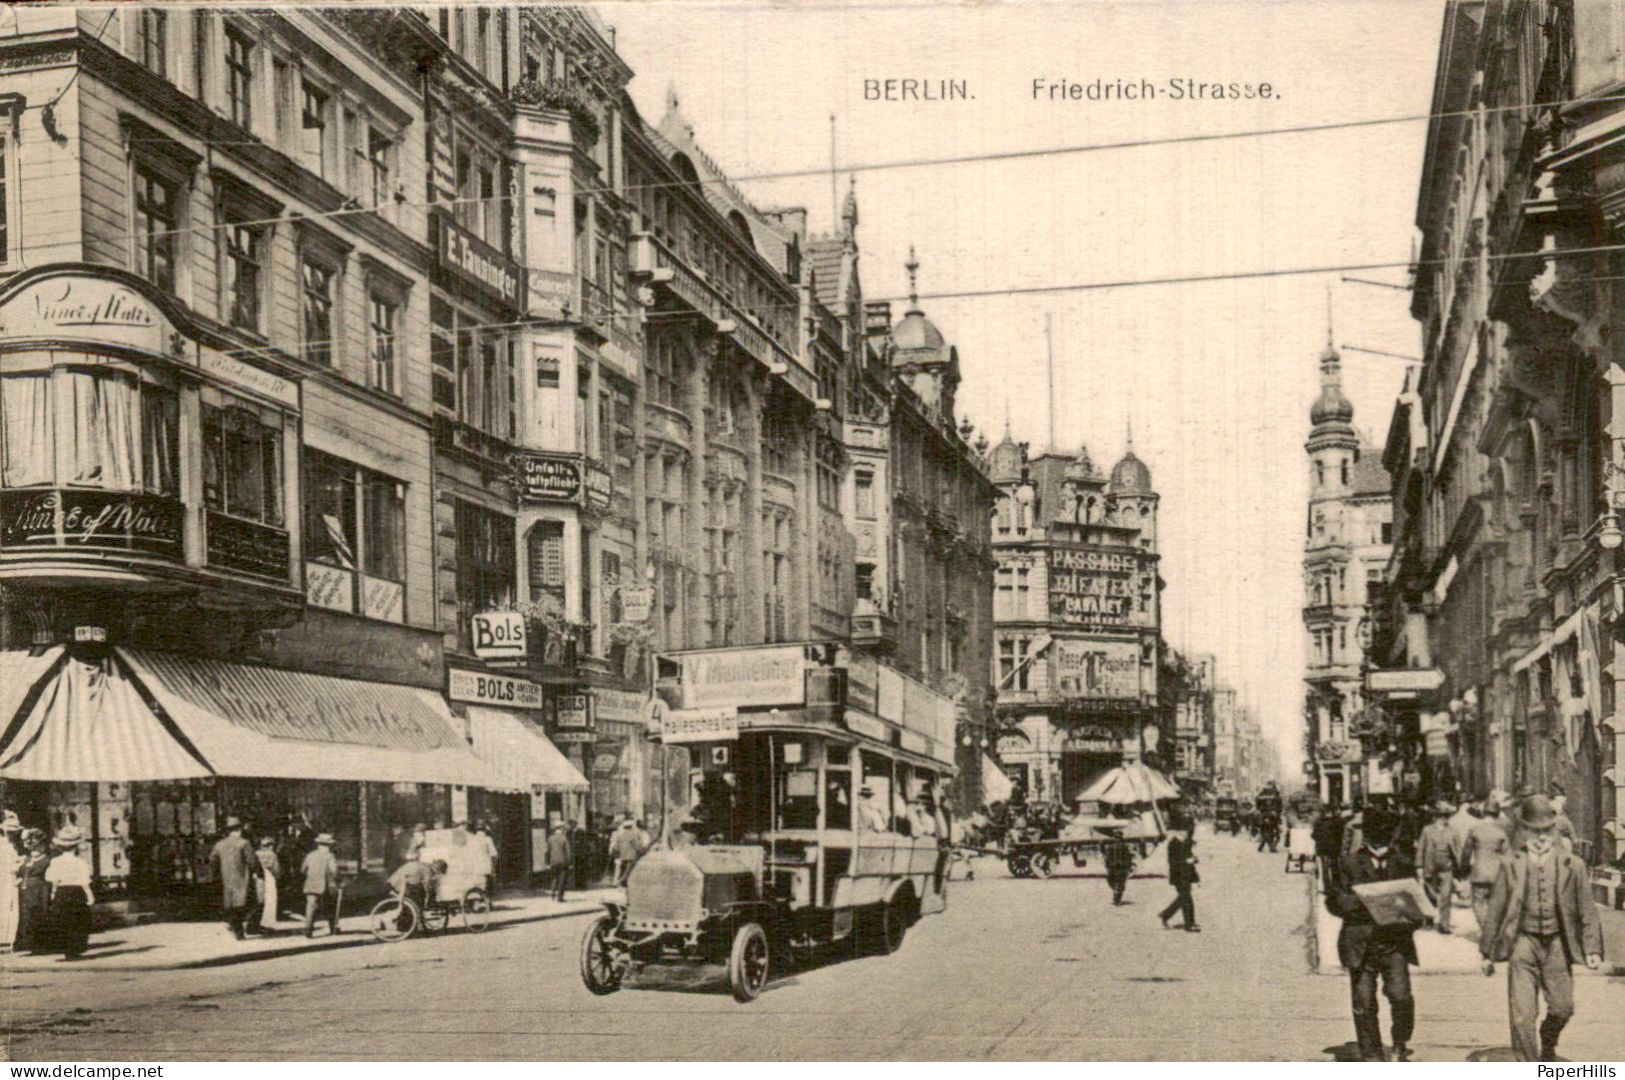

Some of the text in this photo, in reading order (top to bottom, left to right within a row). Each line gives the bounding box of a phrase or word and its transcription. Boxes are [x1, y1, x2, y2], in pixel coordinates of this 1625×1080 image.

[1053, 549, 1137, 571] PASSAGE
[474, 617, 523, 648] Bols
[477, 677, 515, 701] BOLS
[557, 696, 585, 711] BOLS
[651, 702, 662, 721] 4
[715, 748, 725, 762] 4
